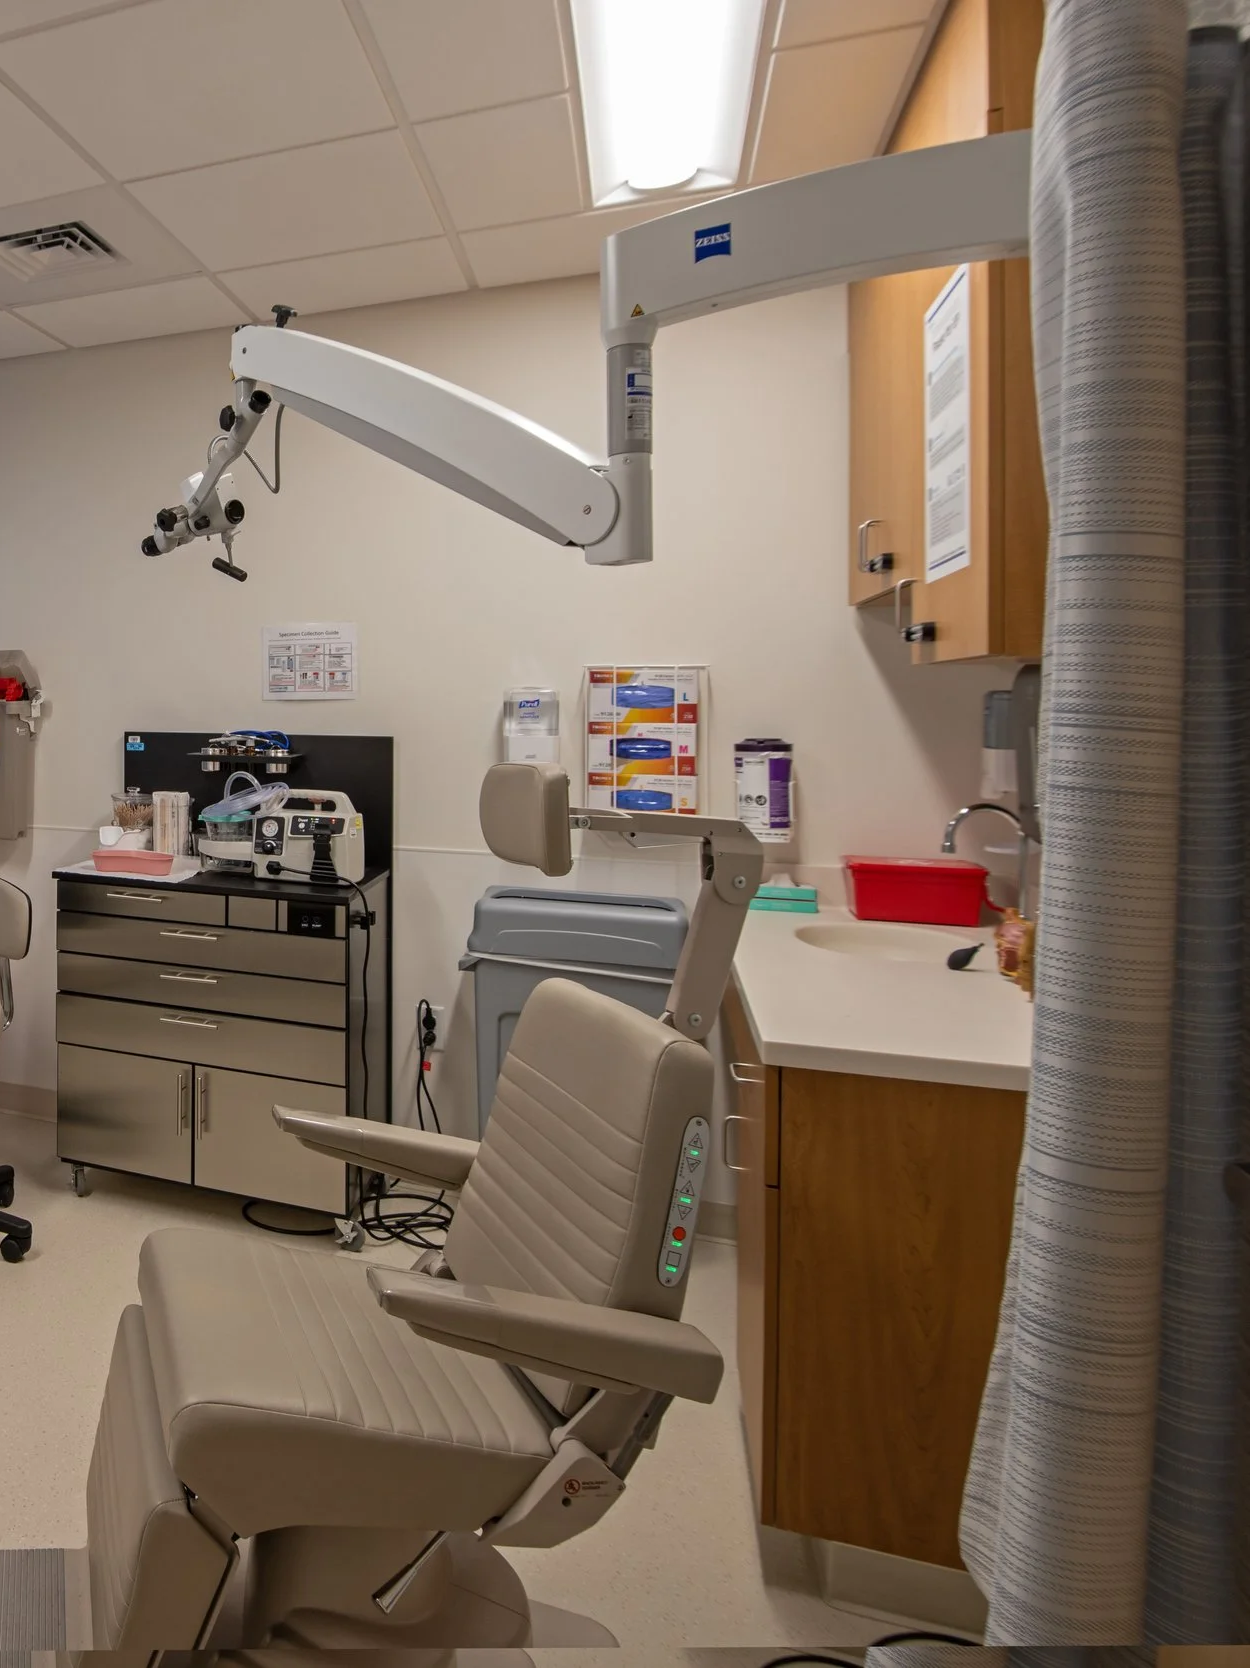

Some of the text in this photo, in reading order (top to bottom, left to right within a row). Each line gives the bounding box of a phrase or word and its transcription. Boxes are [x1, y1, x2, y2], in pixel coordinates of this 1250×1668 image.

[695, 231, 731, 248] ZEISS
[683, 692, 689, 702] L
[678, 745, 688, 754] M
[681, 798, 688, 806] S
